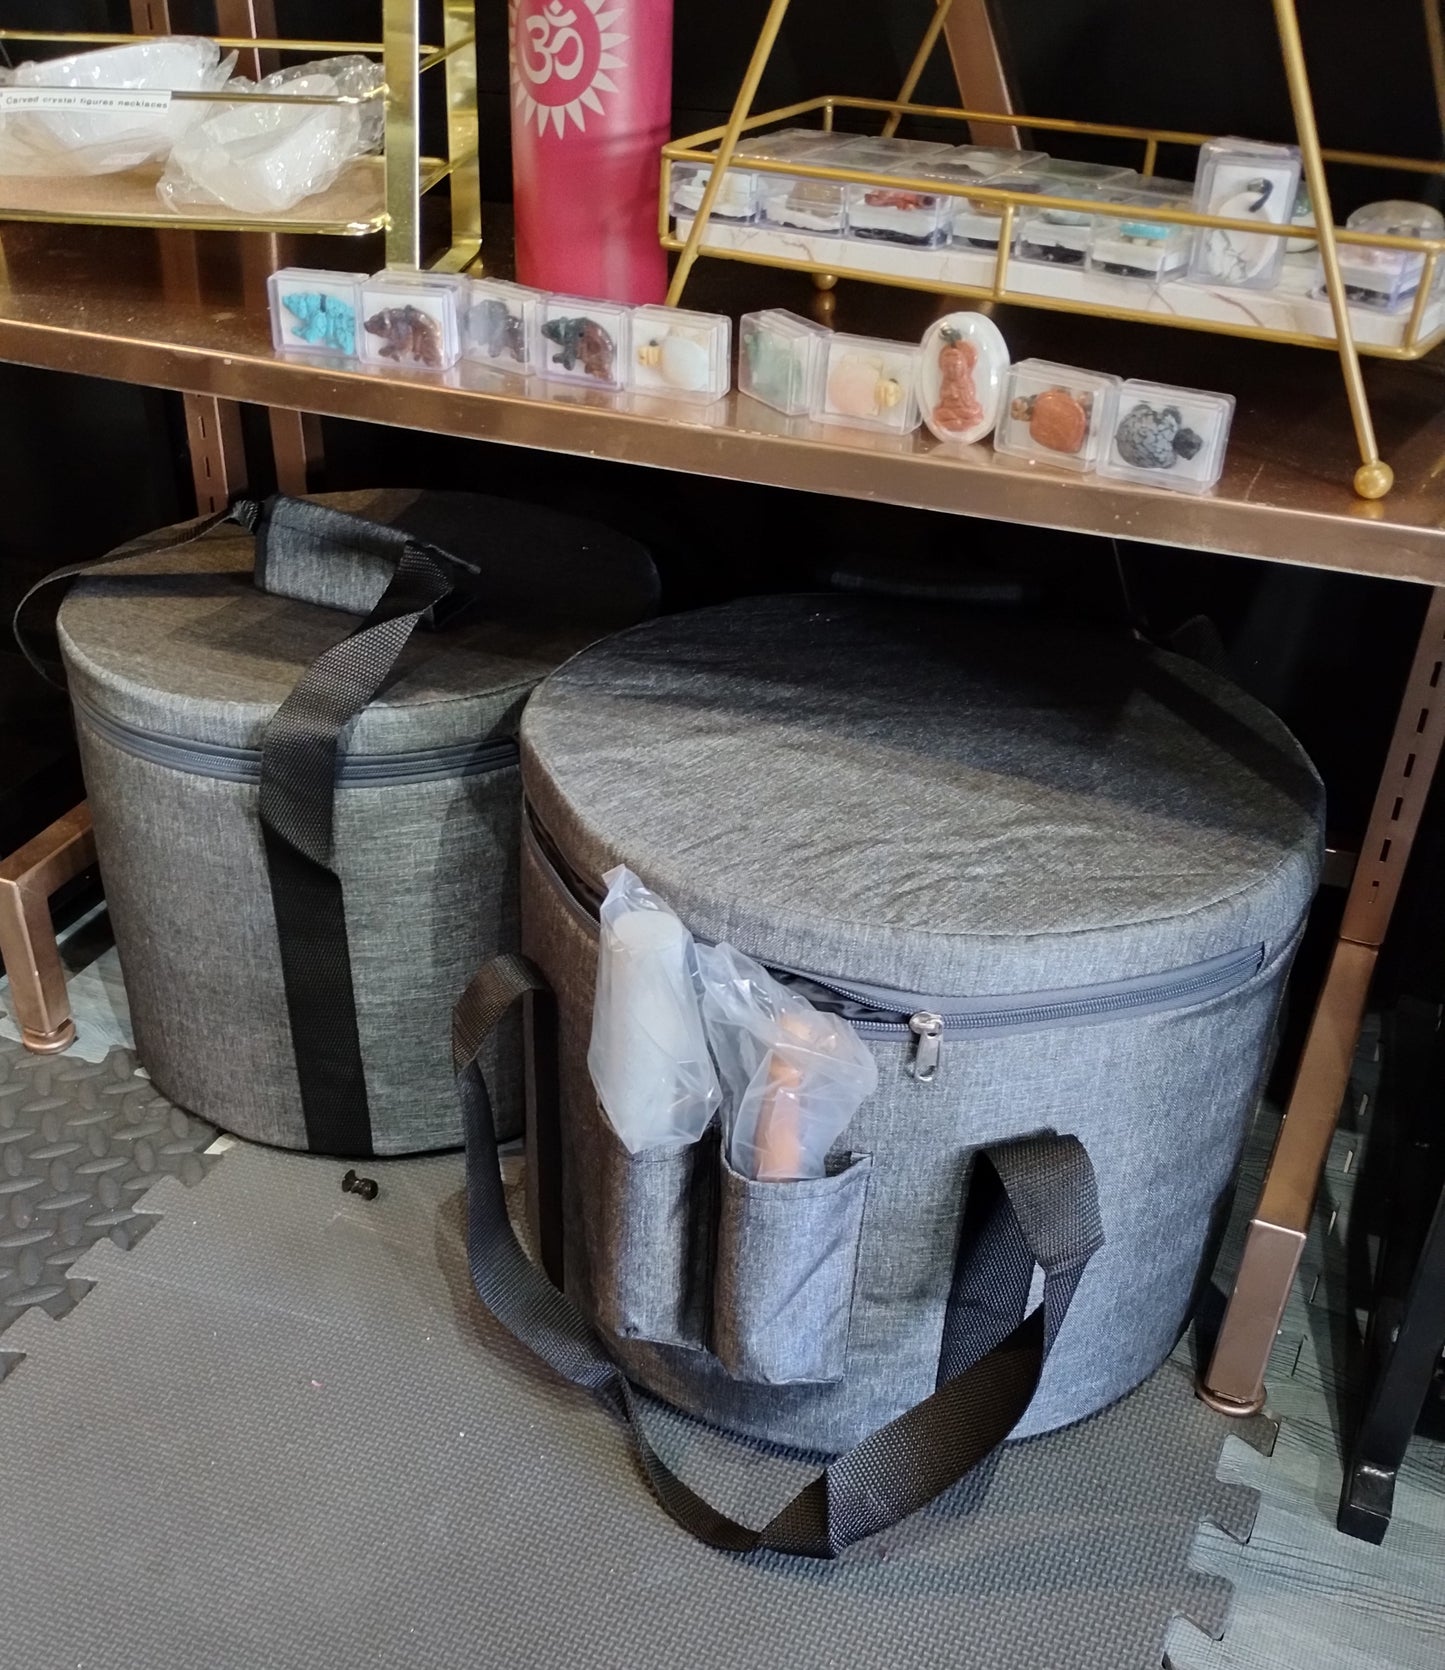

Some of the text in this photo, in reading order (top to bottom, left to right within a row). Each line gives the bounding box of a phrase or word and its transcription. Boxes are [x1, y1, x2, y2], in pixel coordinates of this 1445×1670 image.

[6, 96, 168, 109] Carved crystal figures necklaces
